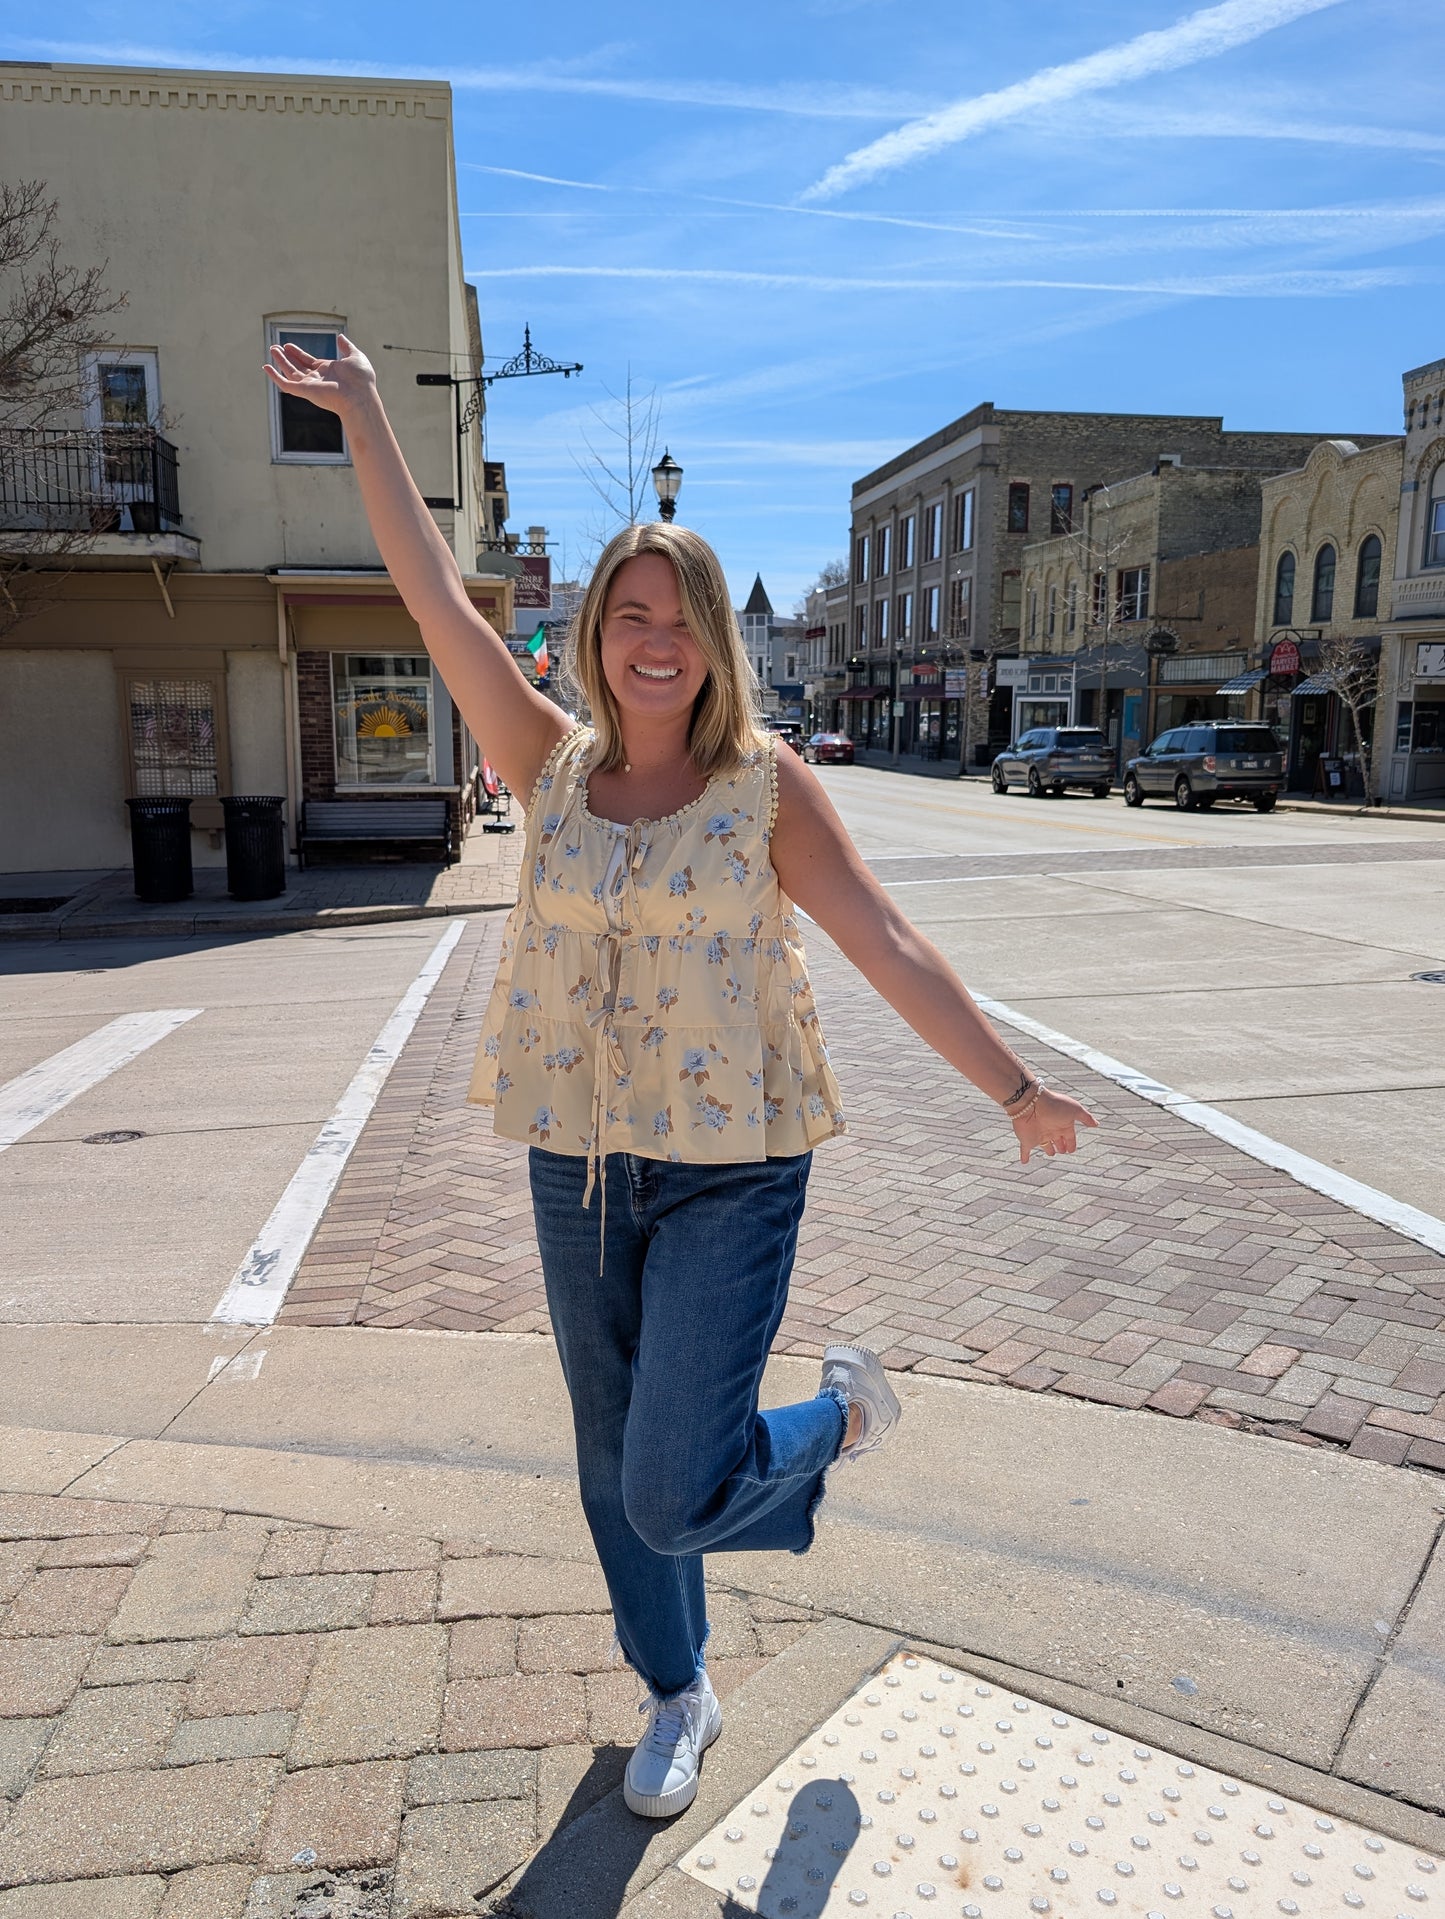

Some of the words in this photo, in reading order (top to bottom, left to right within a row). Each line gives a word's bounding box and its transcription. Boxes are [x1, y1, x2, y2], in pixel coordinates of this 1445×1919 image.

[1271, 656, 1299, 666] HARVEST
[1270, 663, 1299, 674] MARKET
[386, 691, 429, 719] Avenue
